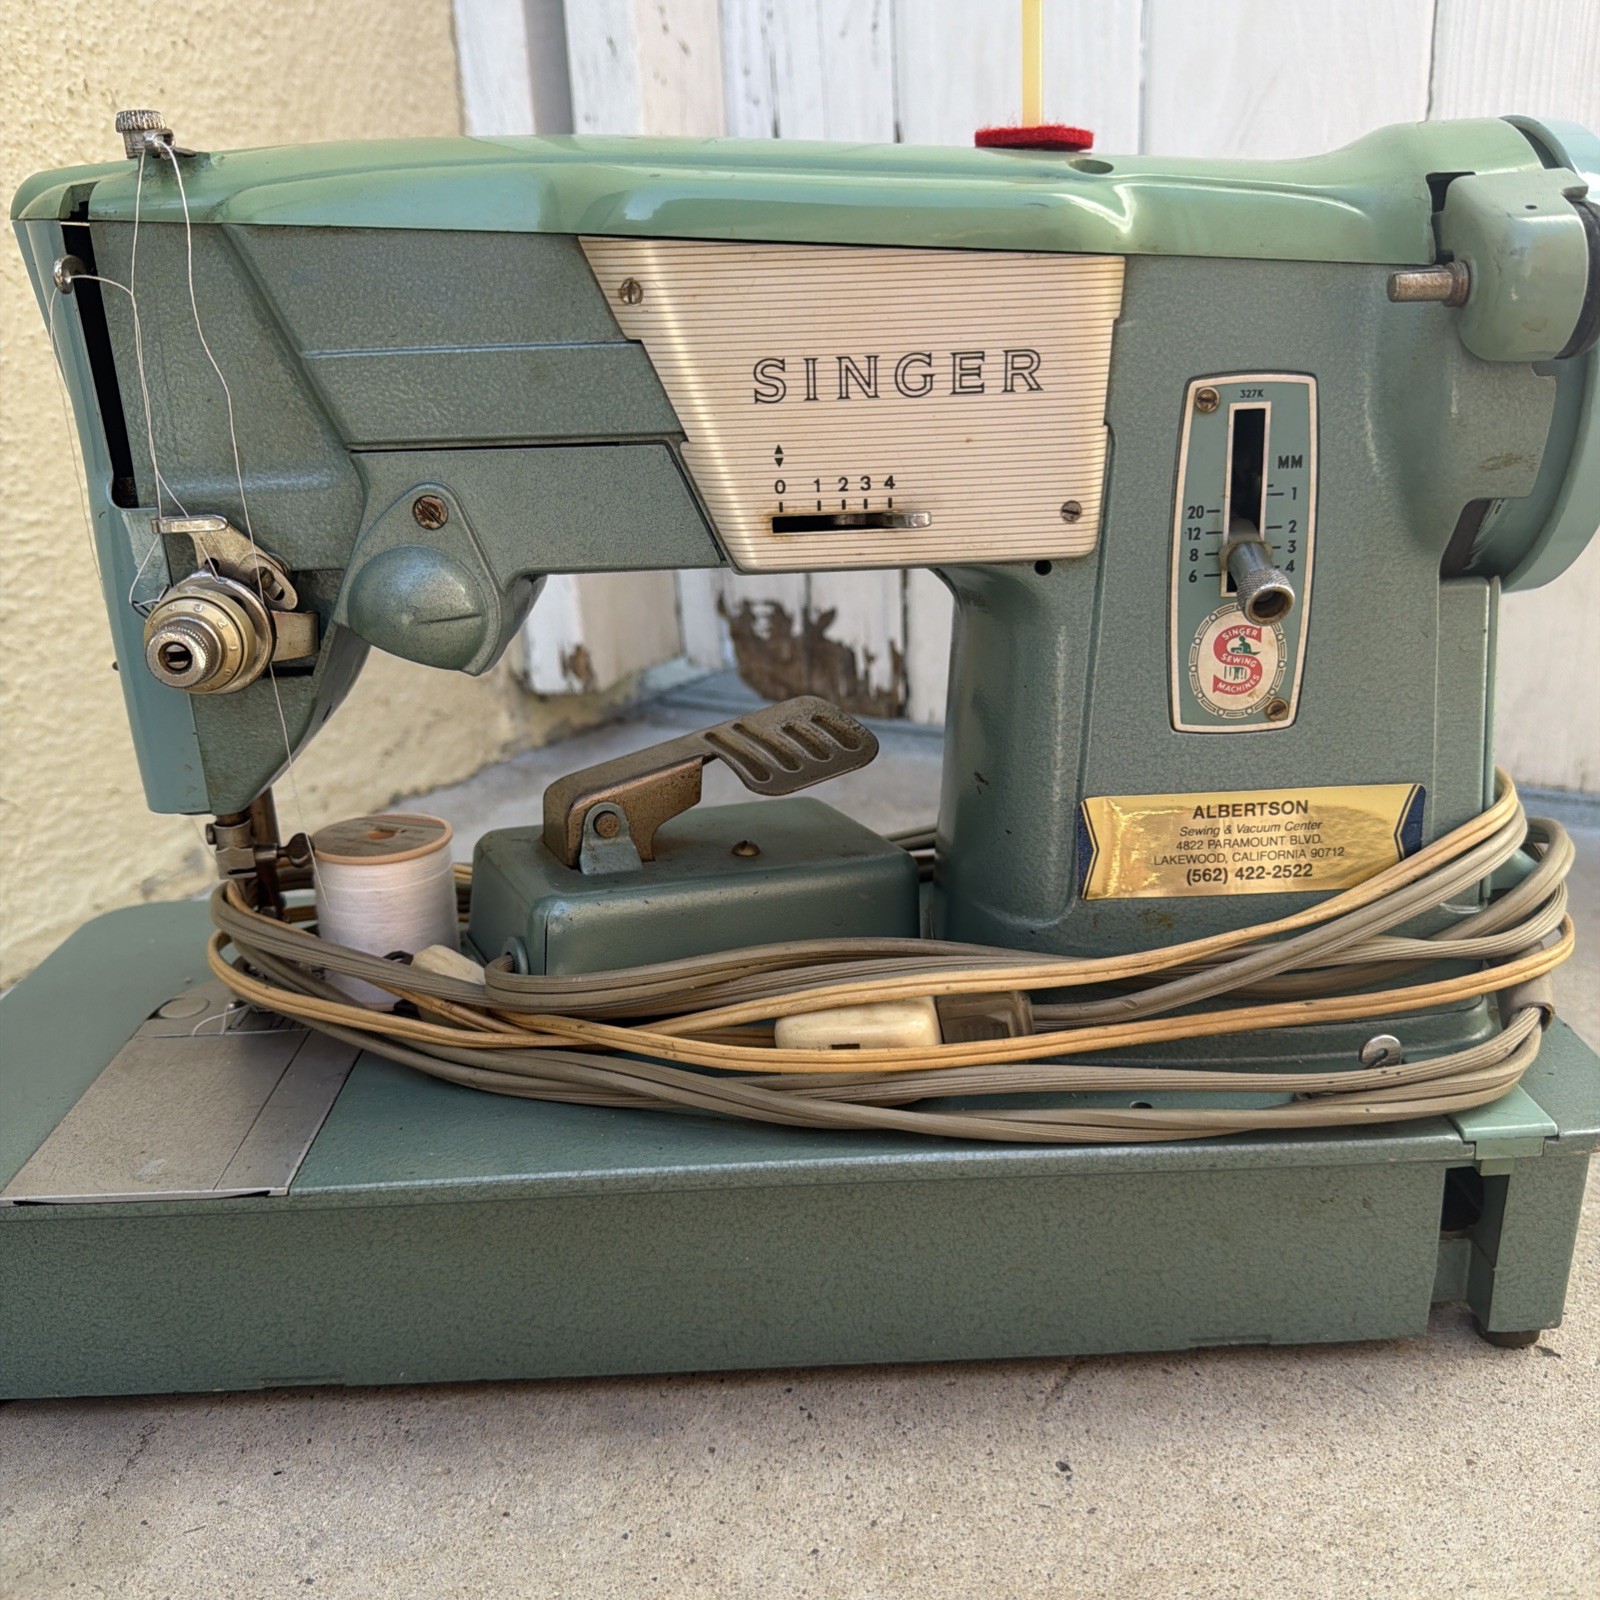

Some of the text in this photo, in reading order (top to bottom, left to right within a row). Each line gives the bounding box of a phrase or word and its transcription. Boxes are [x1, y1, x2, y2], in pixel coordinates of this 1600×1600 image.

[753, 349, 1044, 404] SINGER
[1239, 389, 1264, 398] 327K
[1277, 454, 1303, 469] MM
[774, 475, 895, 494] 0 1 2 3 4
[1291, 487, 1298, 500] 1
[1187, 505, 1204, 519] 20
[1187, 527, 1201, 540] 12
[1288, 520, 1297, 533] 2
[1287, 541, 1296, 553] 3
[1189, 548, 1199, 562] 8
[1285, 560, 1295, 572] 4
[1188, 570, 1198, 583] 6
[218, 618, 228, 629] 2
[1221, 627, 1258, 641] SINGER
[1220, 653, 1258, 668] SEWING
[1216, 674, 1260, 693] MACHINES
[1192, 800, 1309, 819] ALBERTSON
[1179, 820, 1323, 837] Sewing & Vacuum Center
[1176, 834, 1323, 851] 4822 PARAMOUNT BLVD.
[1154, 846, 1345, 866] LAKEWOOD, CALIFORNIA 90712
[1186, 863, 1313, 886] (562) 422-2522
